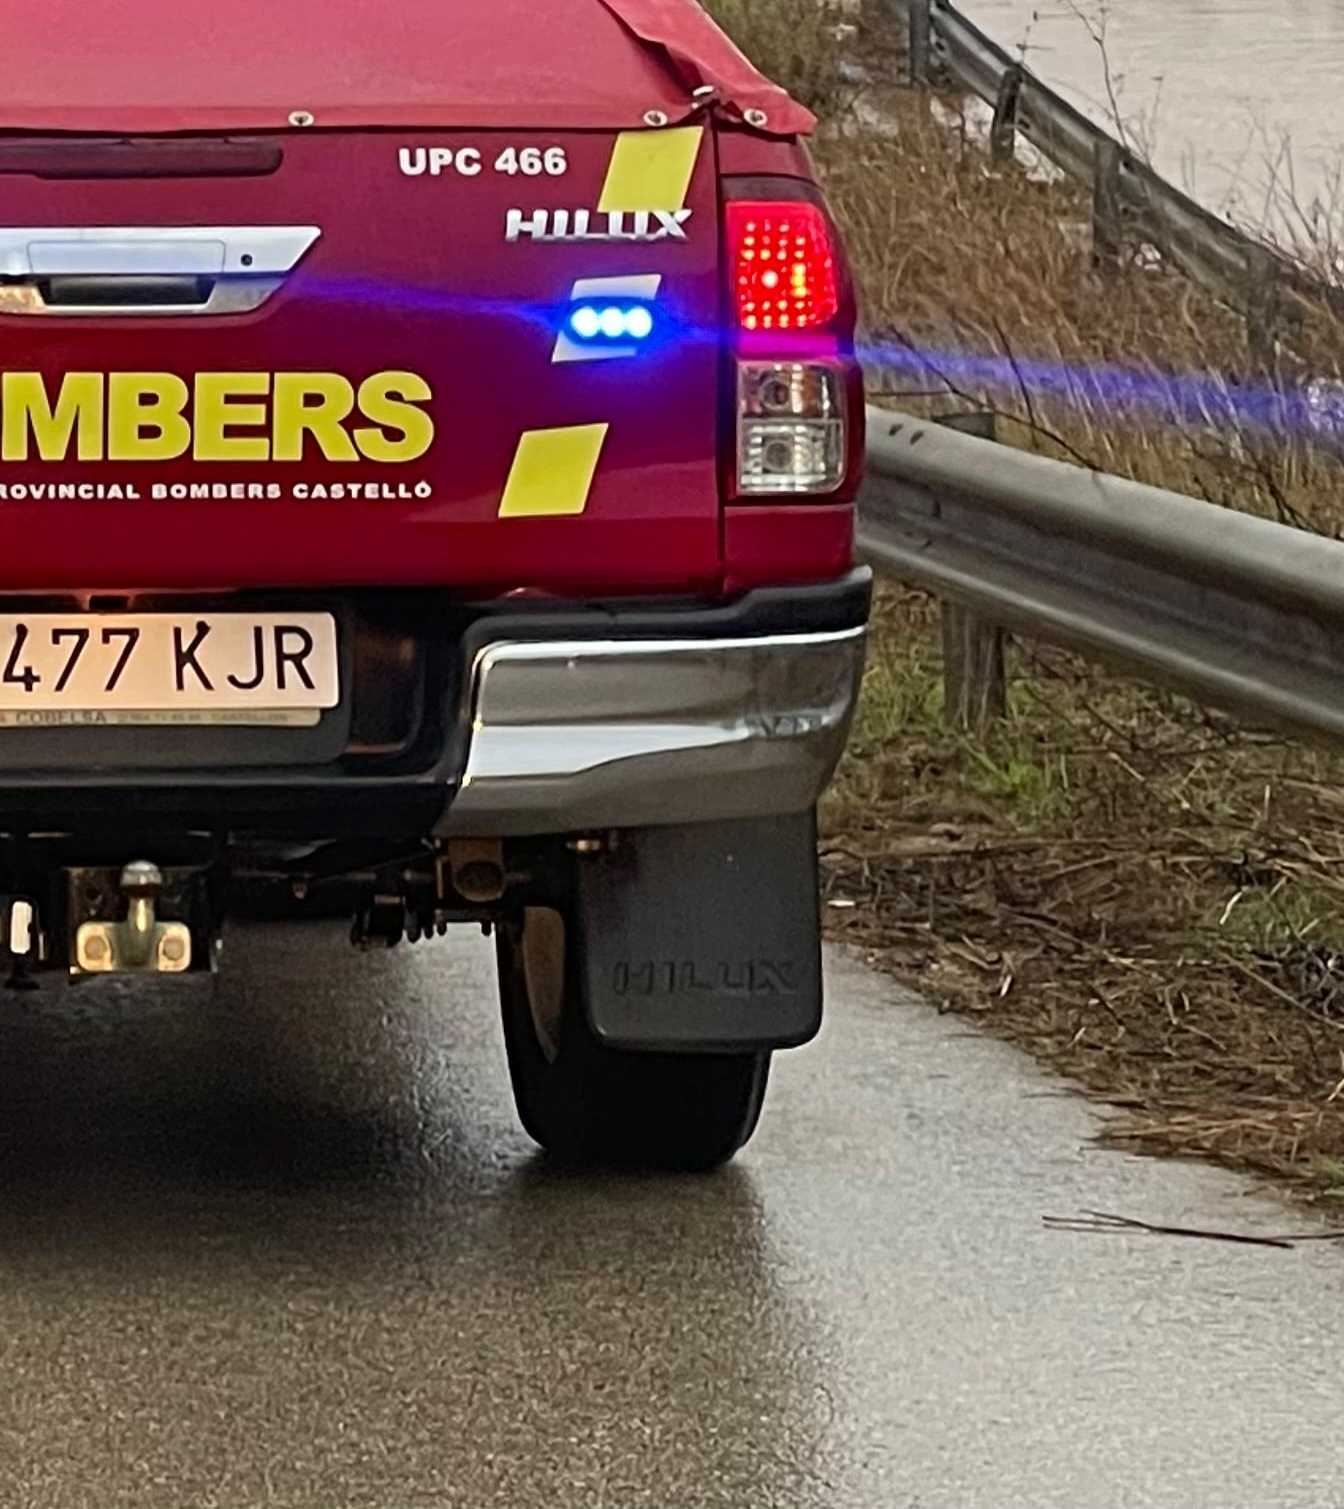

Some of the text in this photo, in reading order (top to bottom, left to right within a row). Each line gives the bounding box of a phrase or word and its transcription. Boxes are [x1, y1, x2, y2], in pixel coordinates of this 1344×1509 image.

[398, 147, 567, 176] UPC 466
[505, 208, 693, 242] HILUX
[152, 483, 282, 500] BOMBERS
[292, 479, 433, 500] CASTELLÓ
[172, 620, 316, 692] KJR
[15, 710, 107, 726] COBELSA
[614, 958, 798, 994] HILUX
